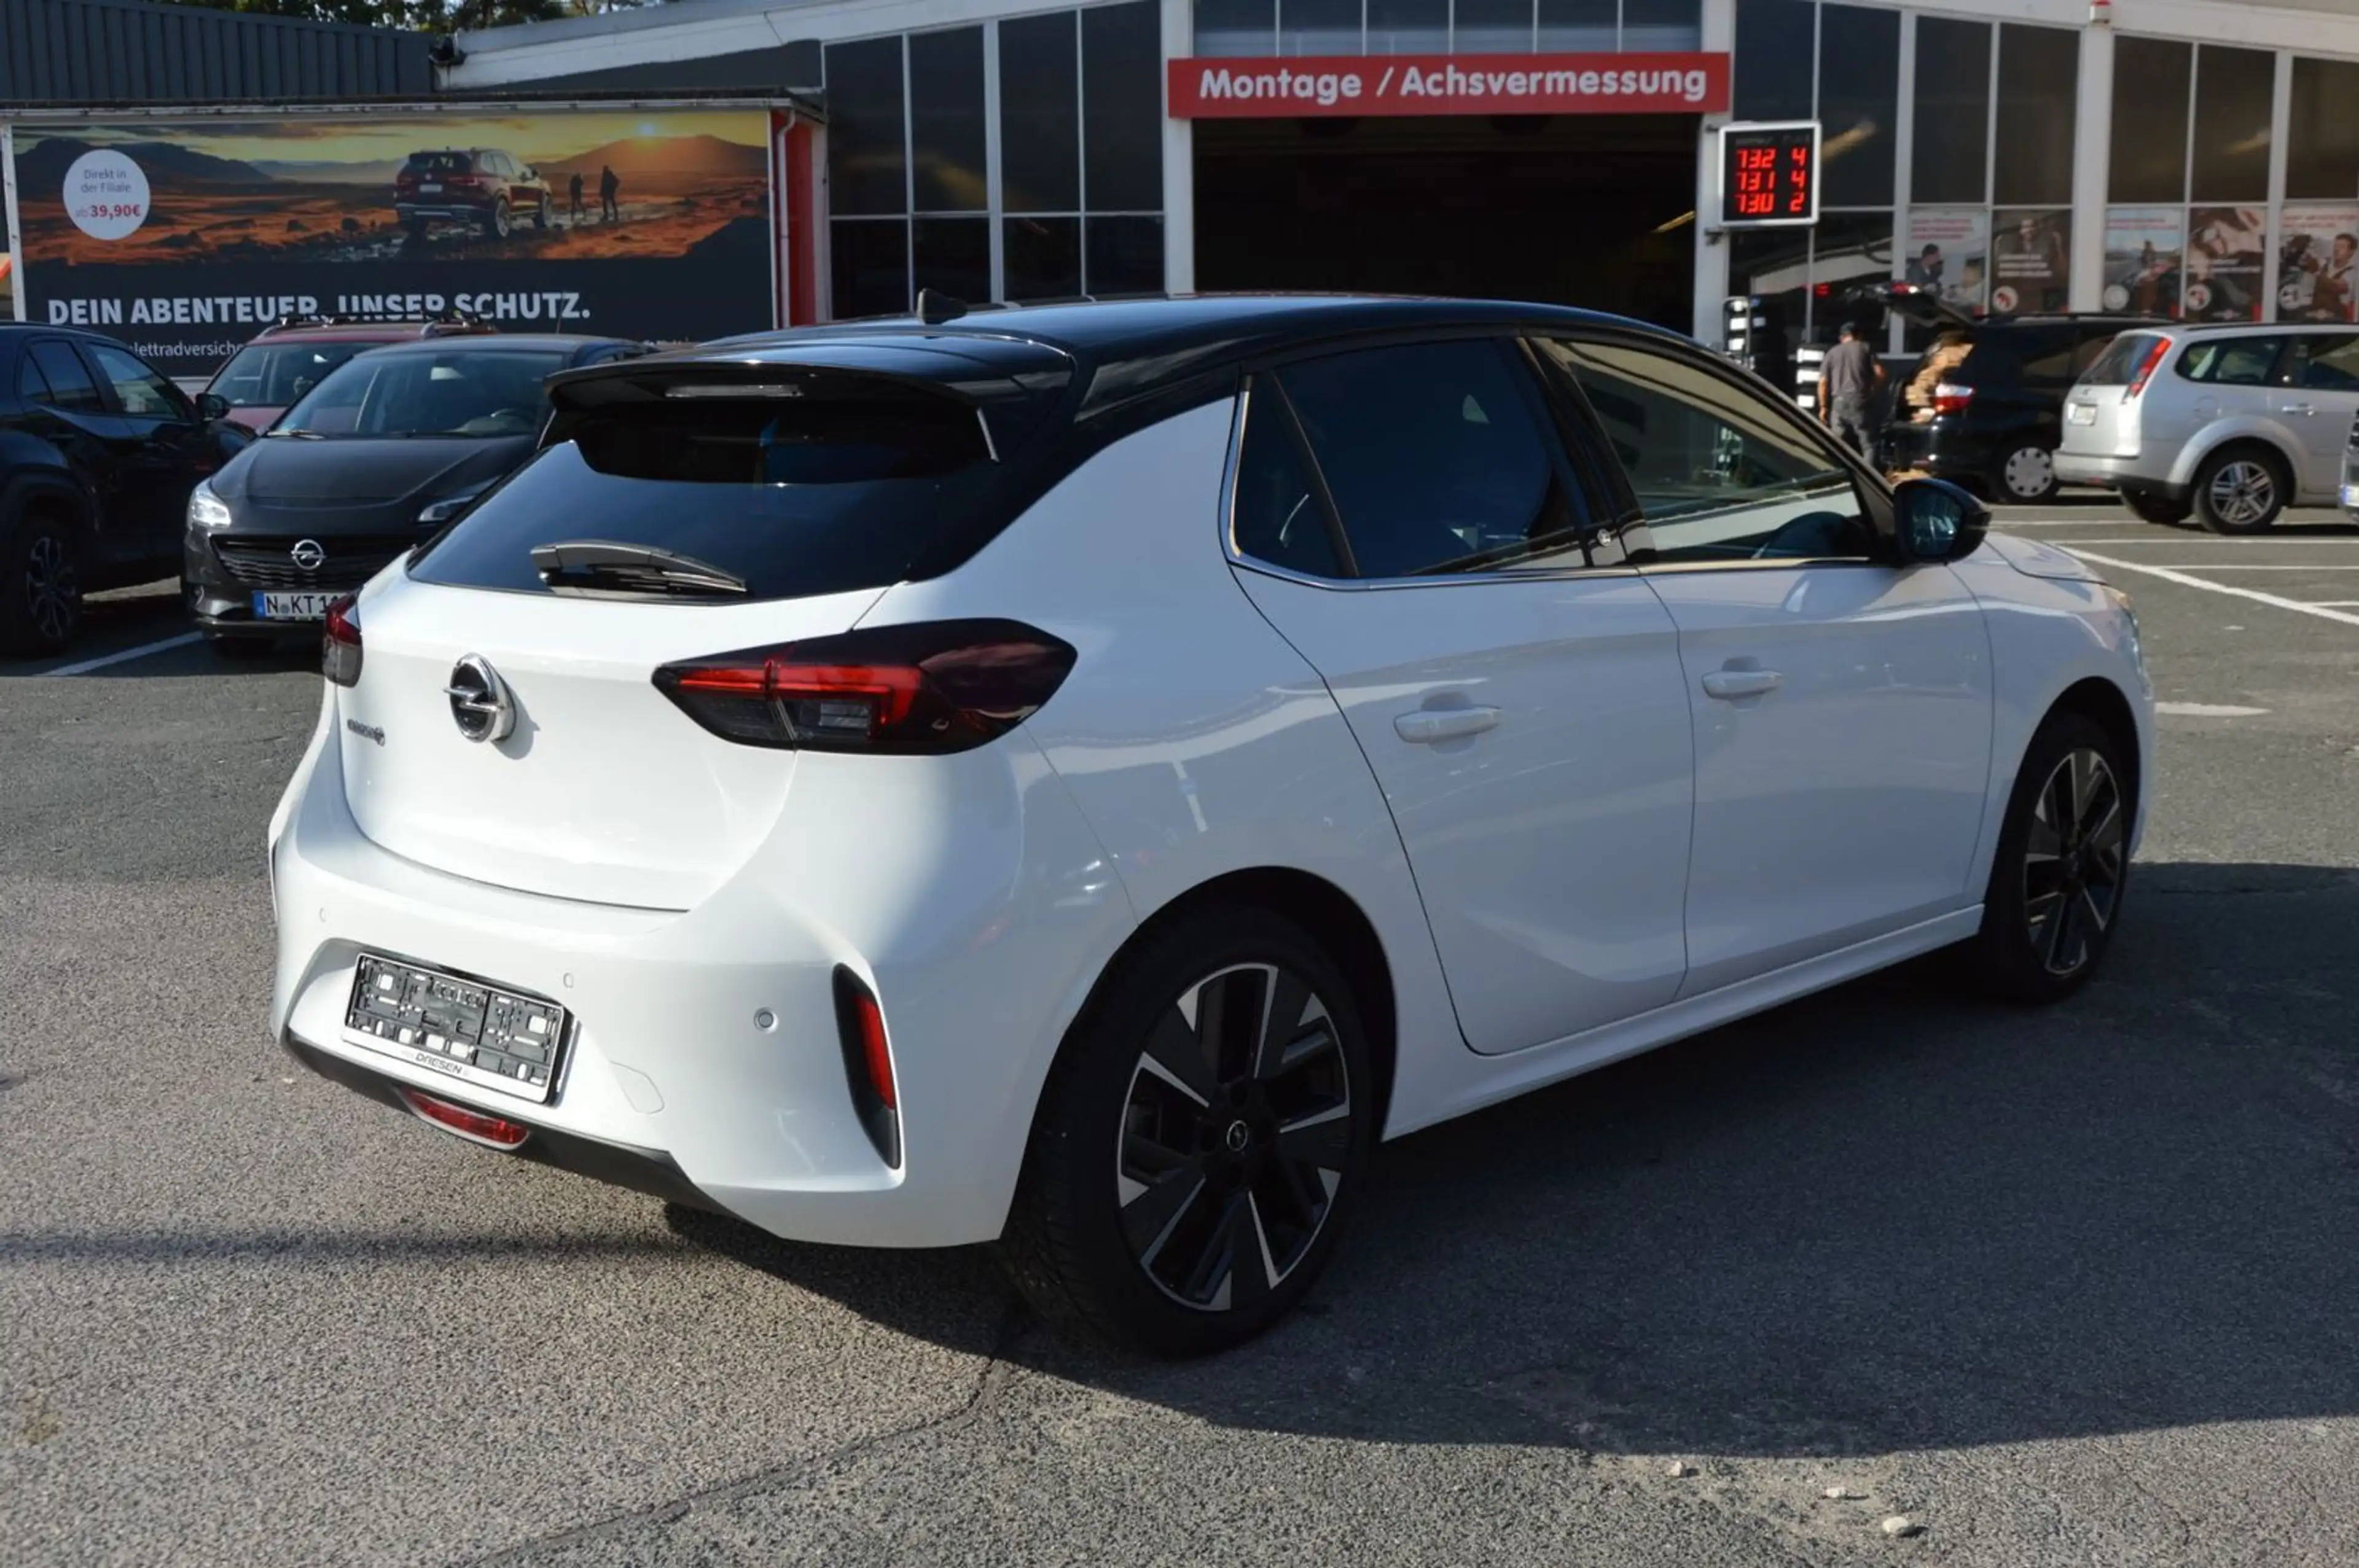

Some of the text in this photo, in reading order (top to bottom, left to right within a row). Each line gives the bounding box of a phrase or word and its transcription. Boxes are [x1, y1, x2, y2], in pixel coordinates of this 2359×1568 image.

[1199, 68, 1362, 106] Montage
[1400, 64, 1707, 101] Achsvermessung
[1791, 147, 1806, 166] 4
[84, 169, 127, 179] Direkt in
[1791, 170, 1805, 189] 4
[81, 182, 131, 193] der Filiale
[1790, 192, 1805, 212] 2
[90, 204, 141, 220] 39,90€
[49, 299, 122, 326] DEIN
[455, 292, 591, 319] SCHUTZ.
[266, 595, 278, 614] N
